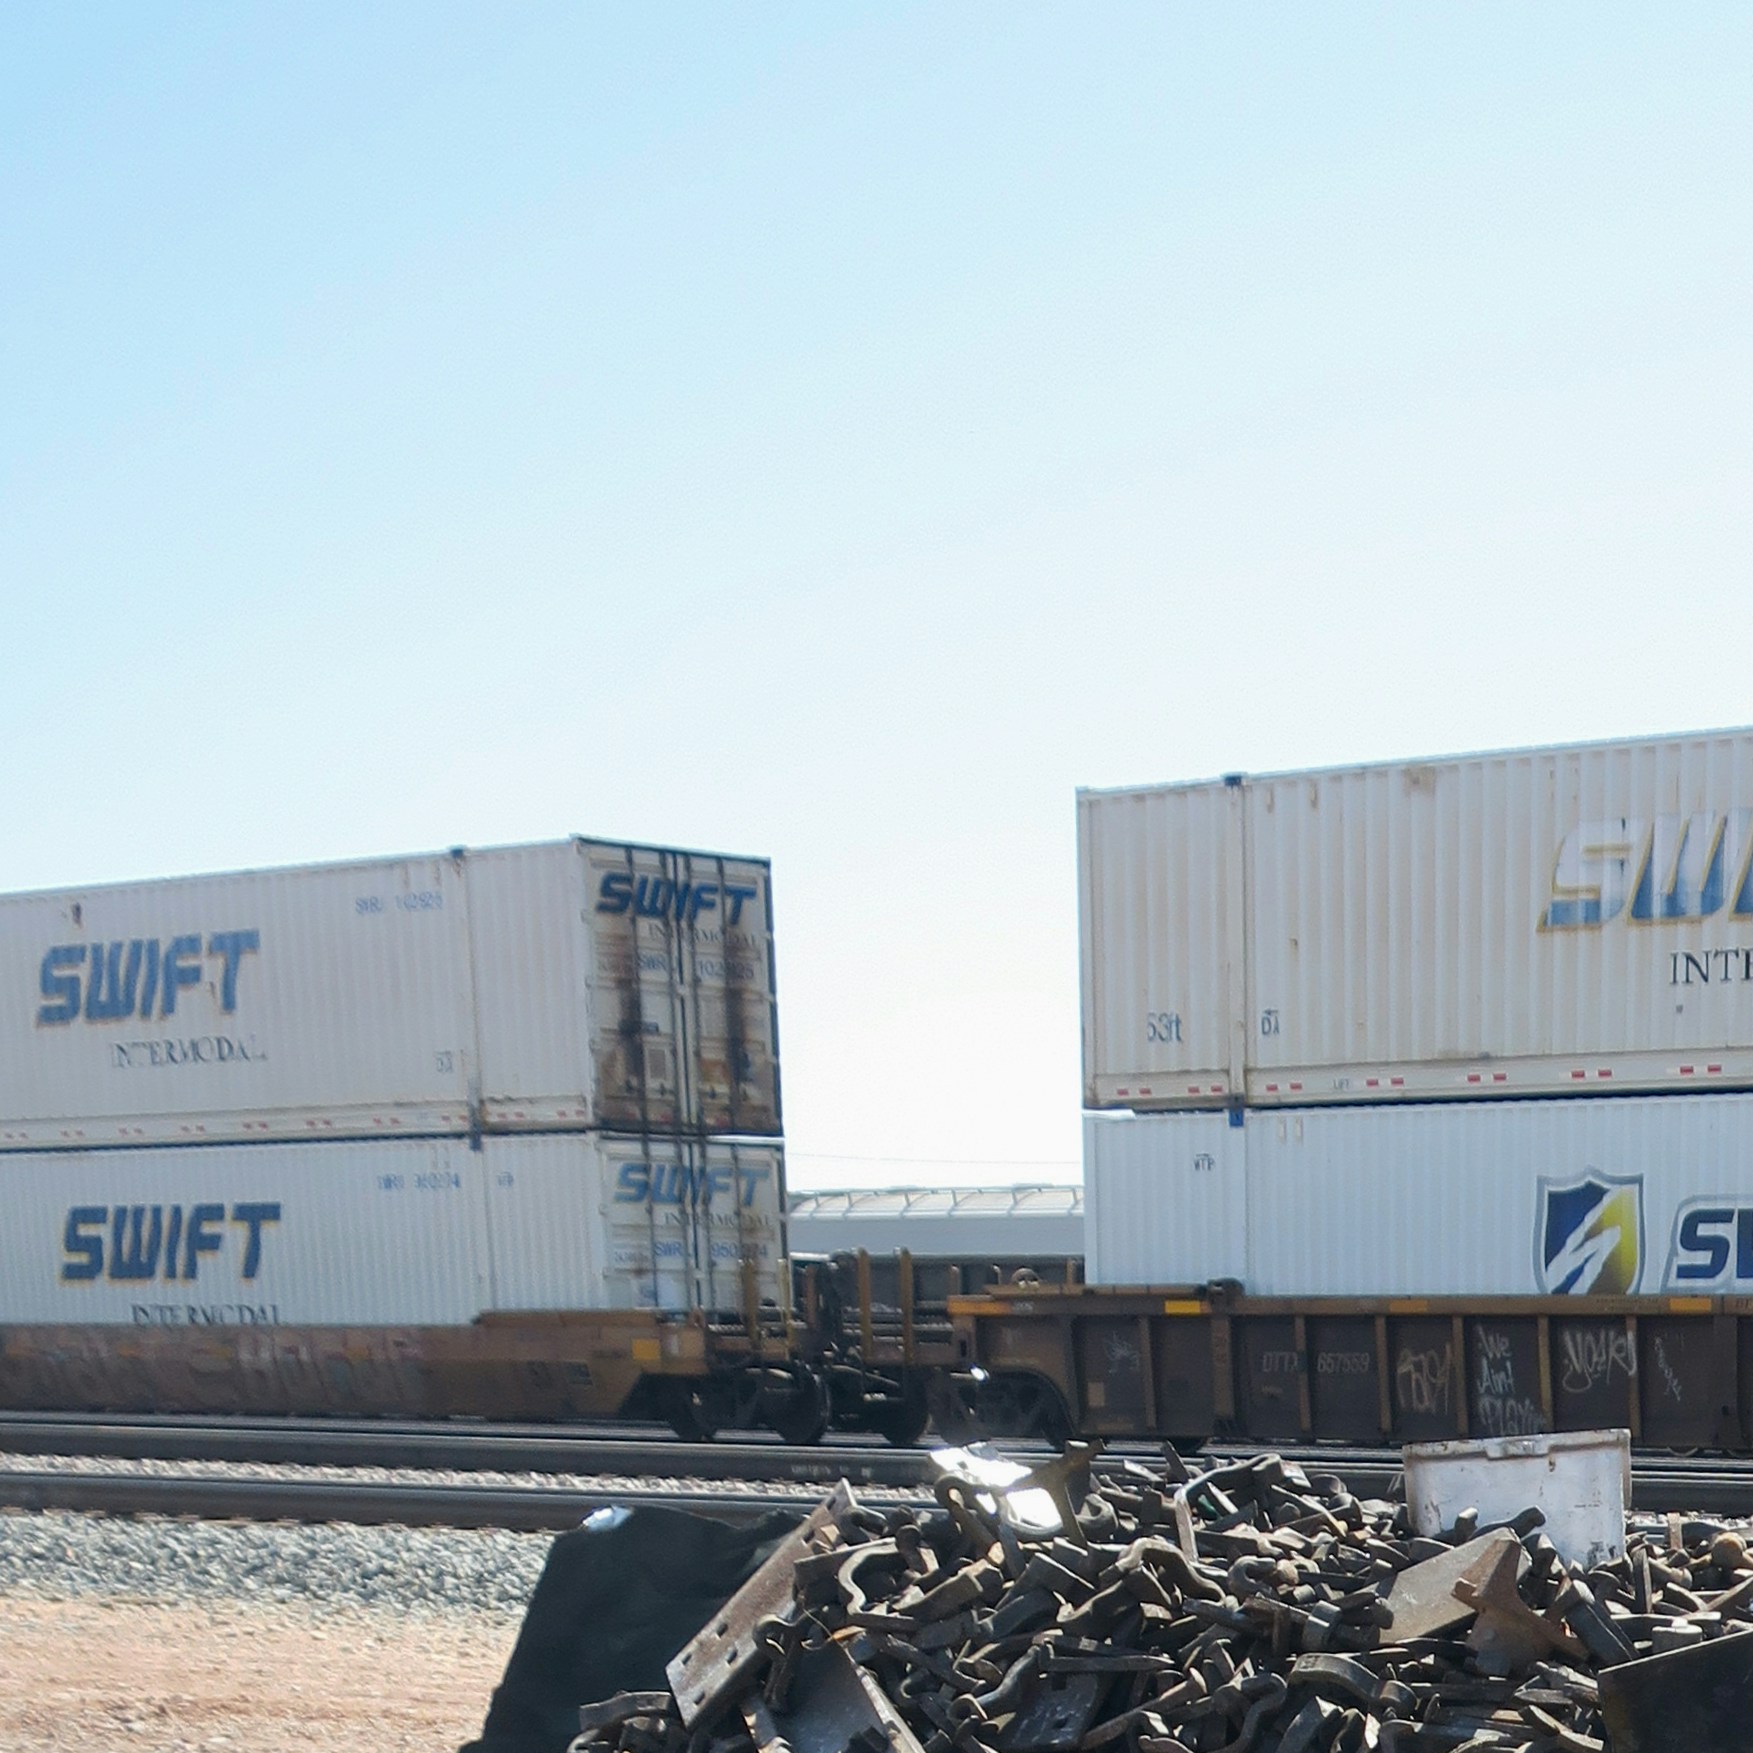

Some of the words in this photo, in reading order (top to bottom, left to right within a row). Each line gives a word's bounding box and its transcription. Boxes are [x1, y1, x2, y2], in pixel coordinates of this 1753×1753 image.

[597, 870, 757, 926] SWIFT
[37, 928, 261, 1028] SWIFT
[614, 1162, 769, 1207] SWIFT
[60, 1202, 282, 1287] SWIFT
